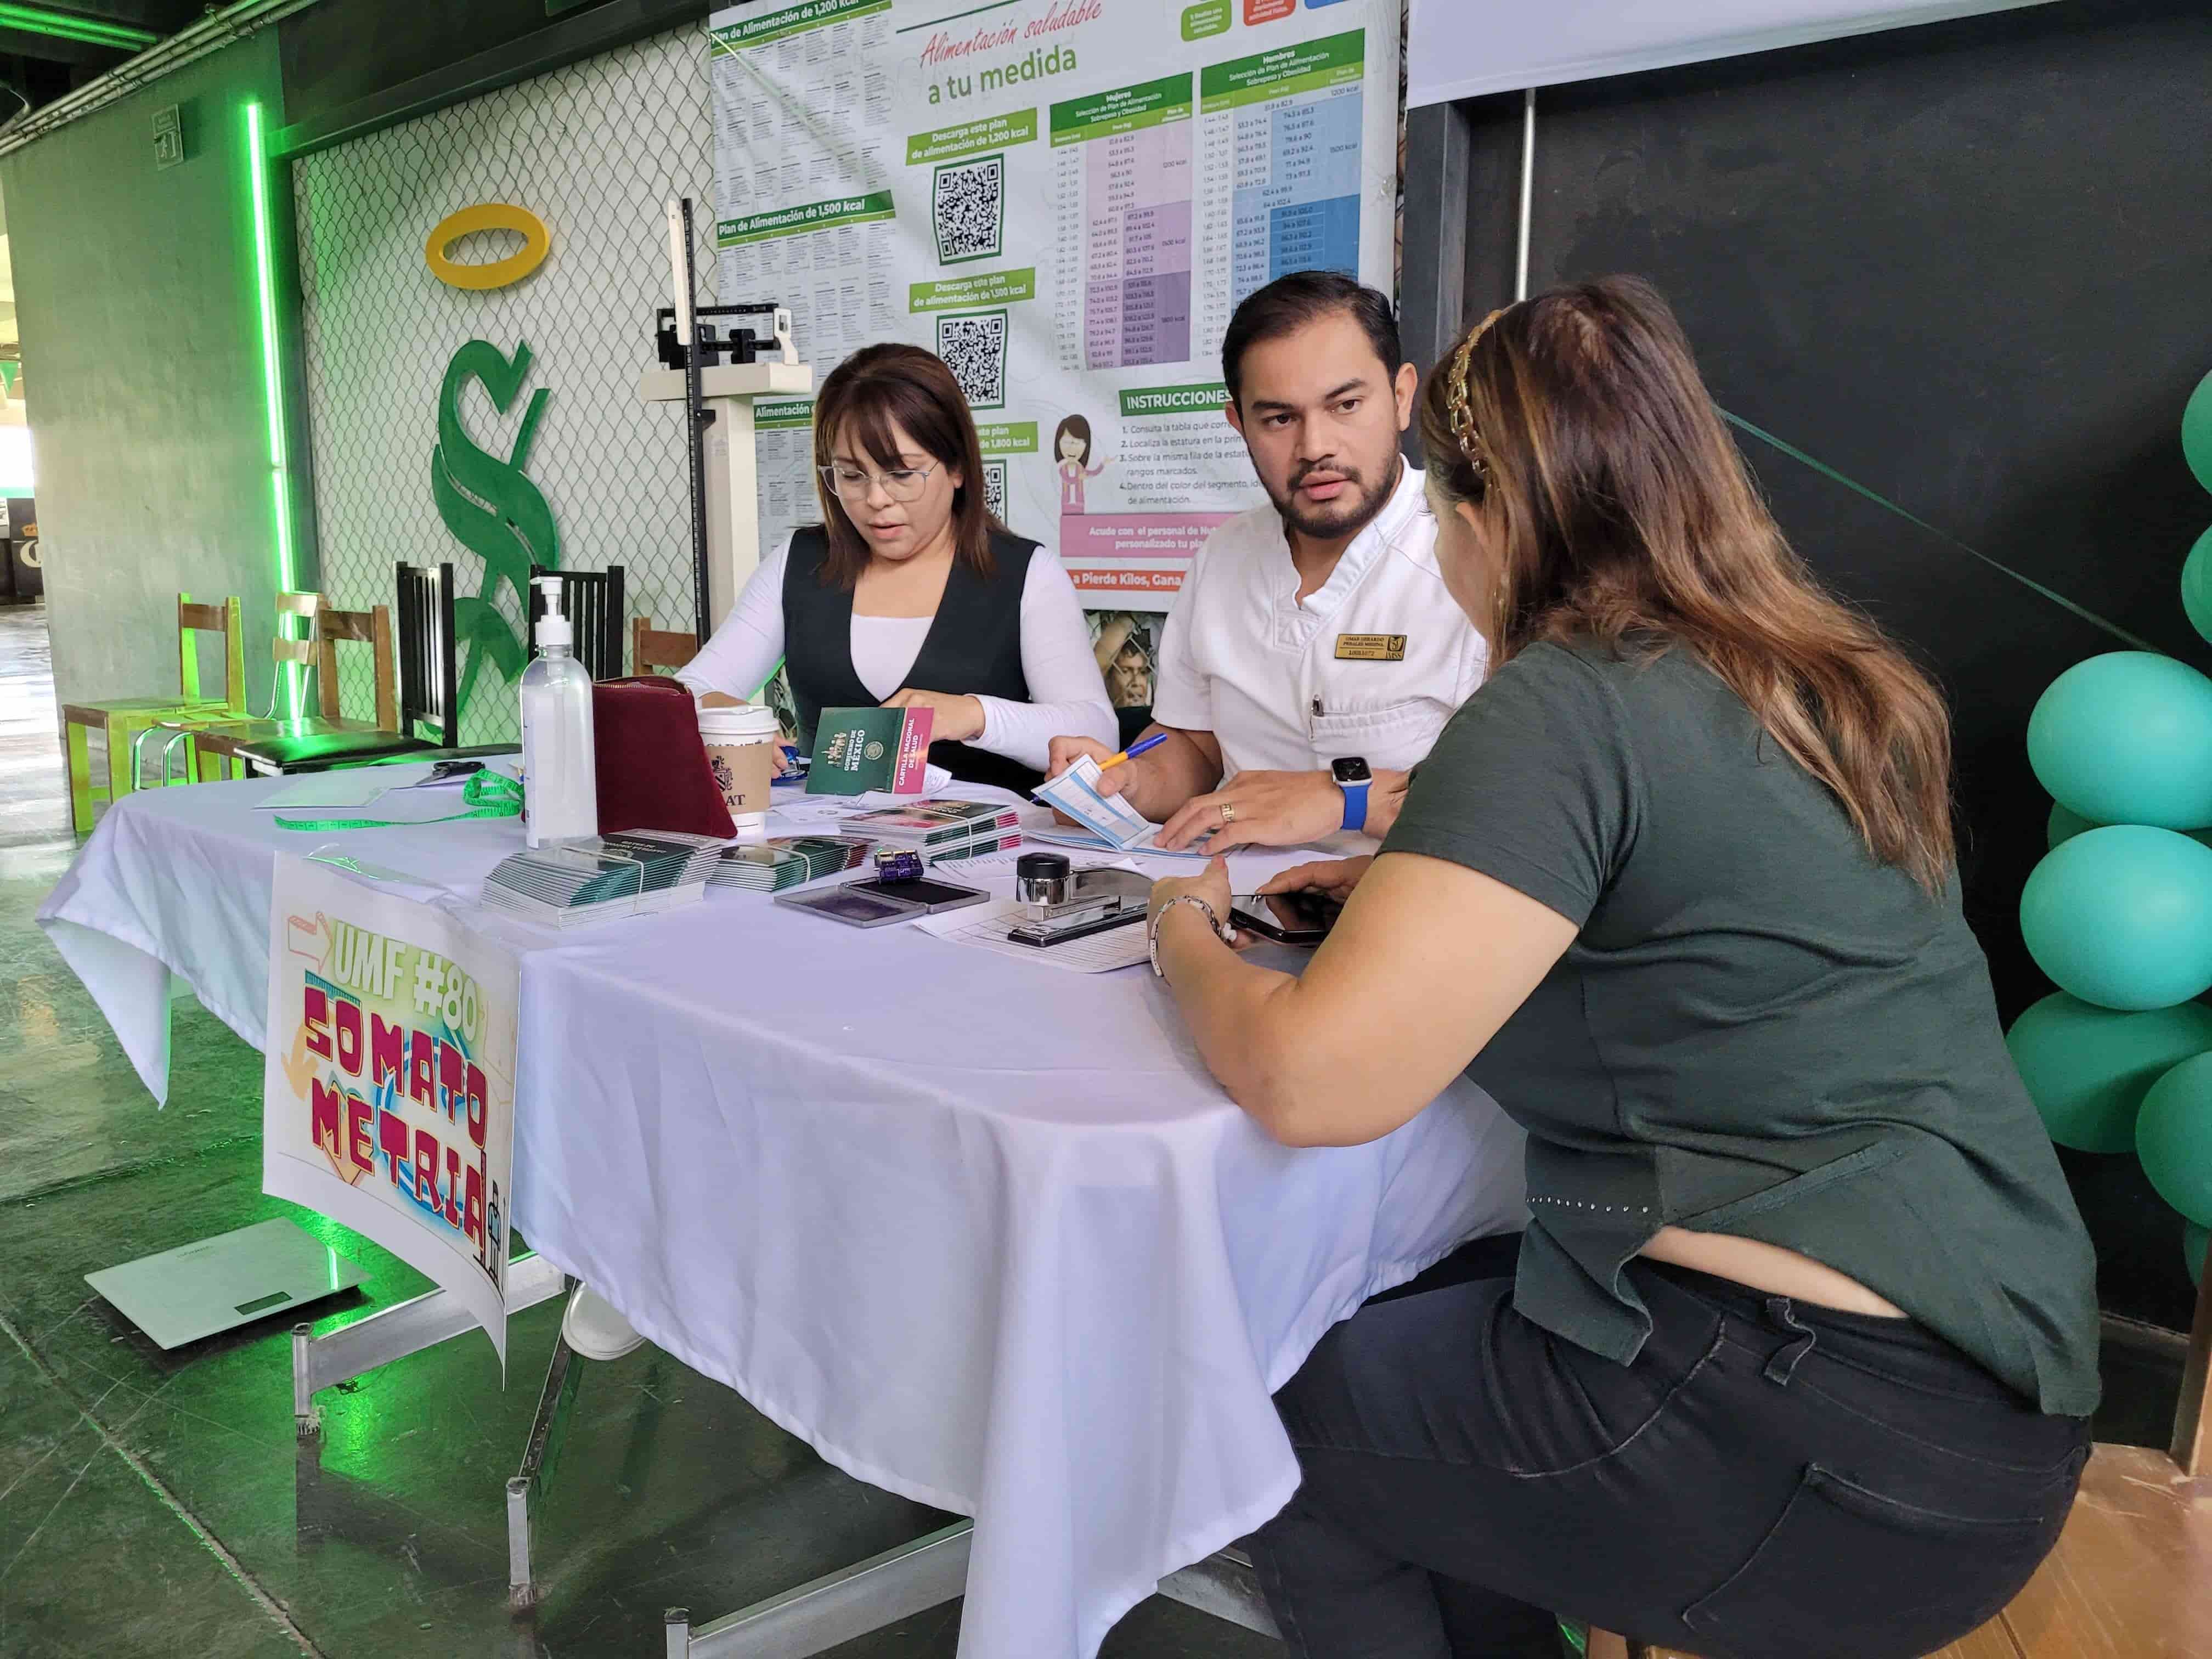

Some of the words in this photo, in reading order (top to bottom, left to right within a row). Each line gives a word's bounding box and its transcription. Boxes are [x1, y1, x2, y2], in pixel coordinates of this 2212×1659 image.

[731, 29, 741, 38] de
[743, 11, 799, 35] Alimentación
[802, 7, 812, 18] de
[920, 19, 1018, 69] Alimentación
[1024, 0, 1102, 38] saludable
[929, 84, 940, 104] a
[947, 76, 971, 99] tu
[980, 45, 1076, 92] medida
[933, 128, 968, 142] Descarga
[970, 123, 987, 133] este
[990, 119, 1007, 131] plan
[912, 150, 923, 159] de
[924, 138, 975, 157] alimentación
[977, 136, 986, 145] de
[1011, 126, 1029, 138] kcal
[719, 223, 736, 235] Plan
[738, 221, 748, 230] de
[749, 210, 804, 229] Alimentación
[805, 206, 816, 217] de
[818, 202, 841, 217] 1,500
[843, 199, 865, 212] kcal
[935, 282, 973, 292] Descarga
[990, 275, 1006, 286] plan
[913, 298, 924, 307] de
[926, 291, 979, 305] alimentación
[981, 291, 990, 300] de
[1009, 284, 1026, 295] kcal
[1127, 390, 1233, 409] INSTRUCCIONES
[755, 404, 809, 417] Alimentación
[1172, 422, 1190, 431] tabla
[1193, 422, 1209, 430] que
[1013, 437, 1030, 447] kcal
[1130, 439, 1160, 448] Localiza
[1126, 468, 1154, 477] rangos
[1137, 527, 1146, 535] el
[1147, 526, 1186, 537] personal
[1187, 527, 1198, 535] de
[1082, 572, 1118, 585] Pierde
[1120, 573, 1150, 586] Kilos,
[1152, 574, 1181, 586] Gana
[850, 730, 857, 738] DE
[850, 730, 865, 771] MÉXICO
[908, 759, 914, 769] DE
[725, 794, 746, 806] AT
[334, 920, 407, 1000] UMF
[413, 947, 478, 1042] #80
[303, 985, 488, 1151] SOMATO
[311, 1076, 486, 1251] METRIA
